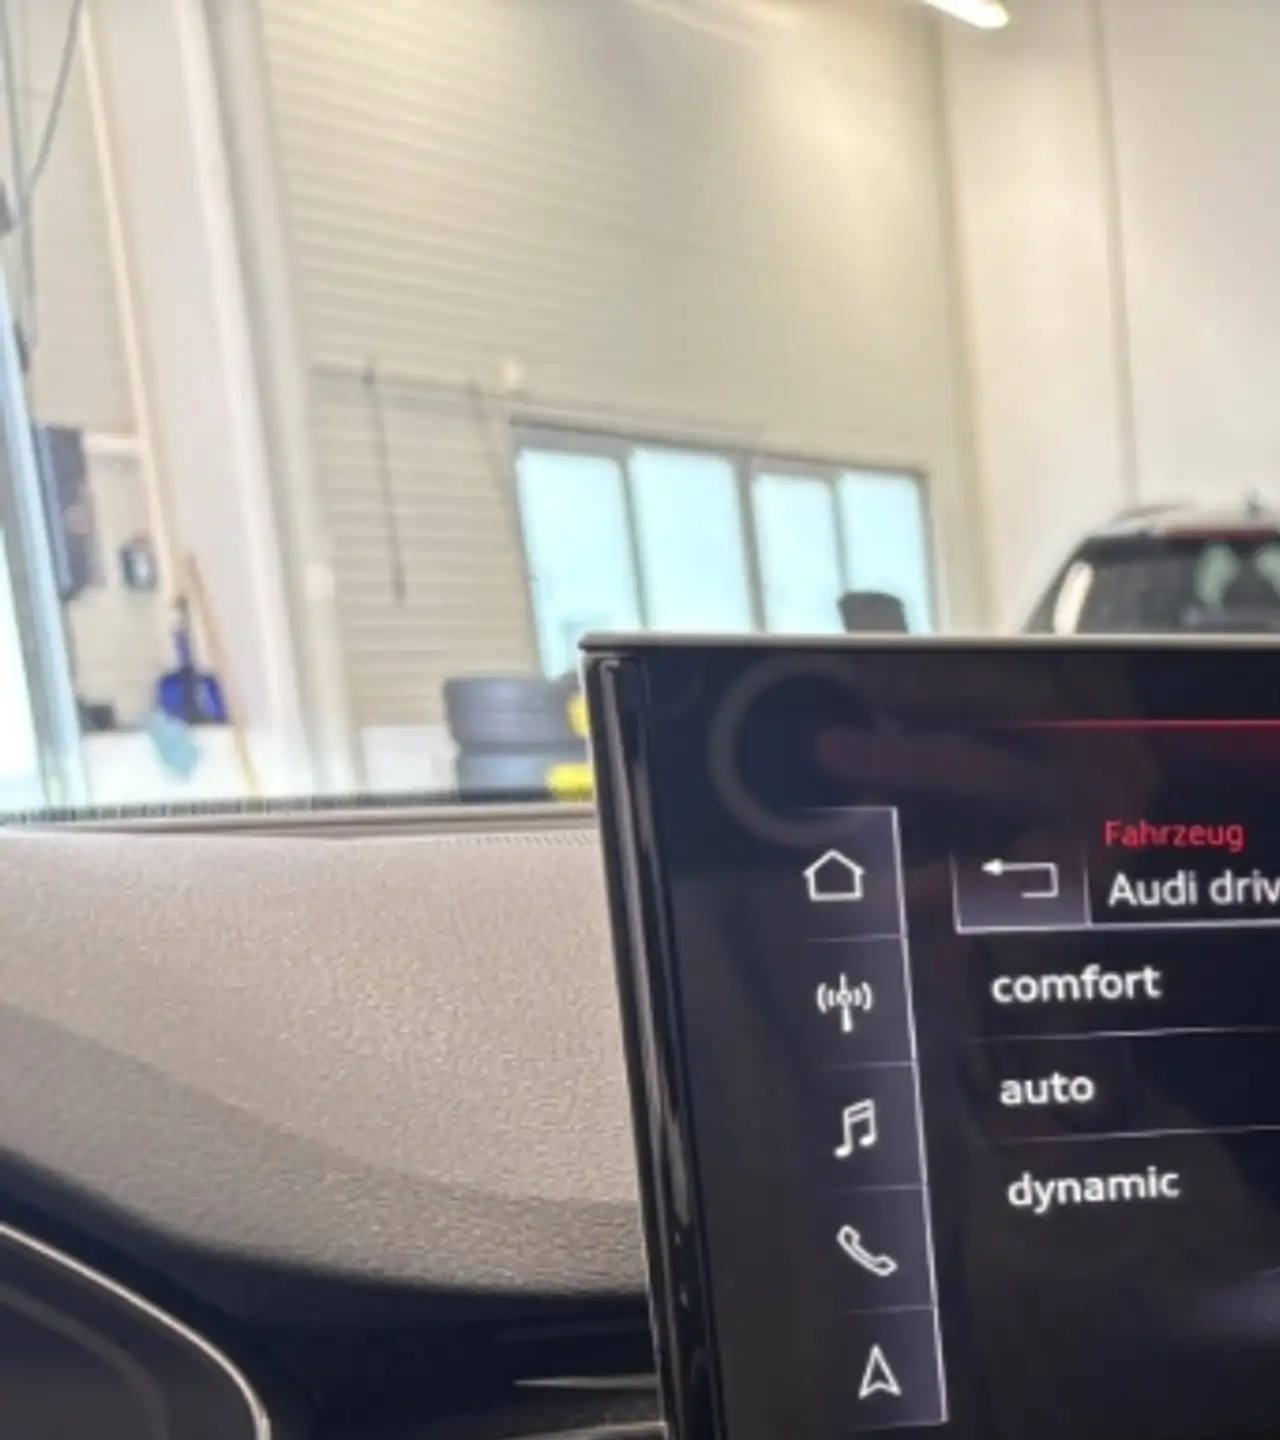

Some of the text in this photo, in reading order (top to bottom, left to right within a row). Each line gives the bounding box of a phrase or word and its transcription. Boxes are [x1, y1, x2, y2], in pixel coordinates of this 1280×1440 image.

[1105, 821, 1245, 853] Fahrzeug
[1108, 870, 1198, 906] Audi
[991, 964, 1163, 1003] comfort
[999, 1072, 1096, 1106] auto
[1007, 1166, 1182, 1216] dynamic
